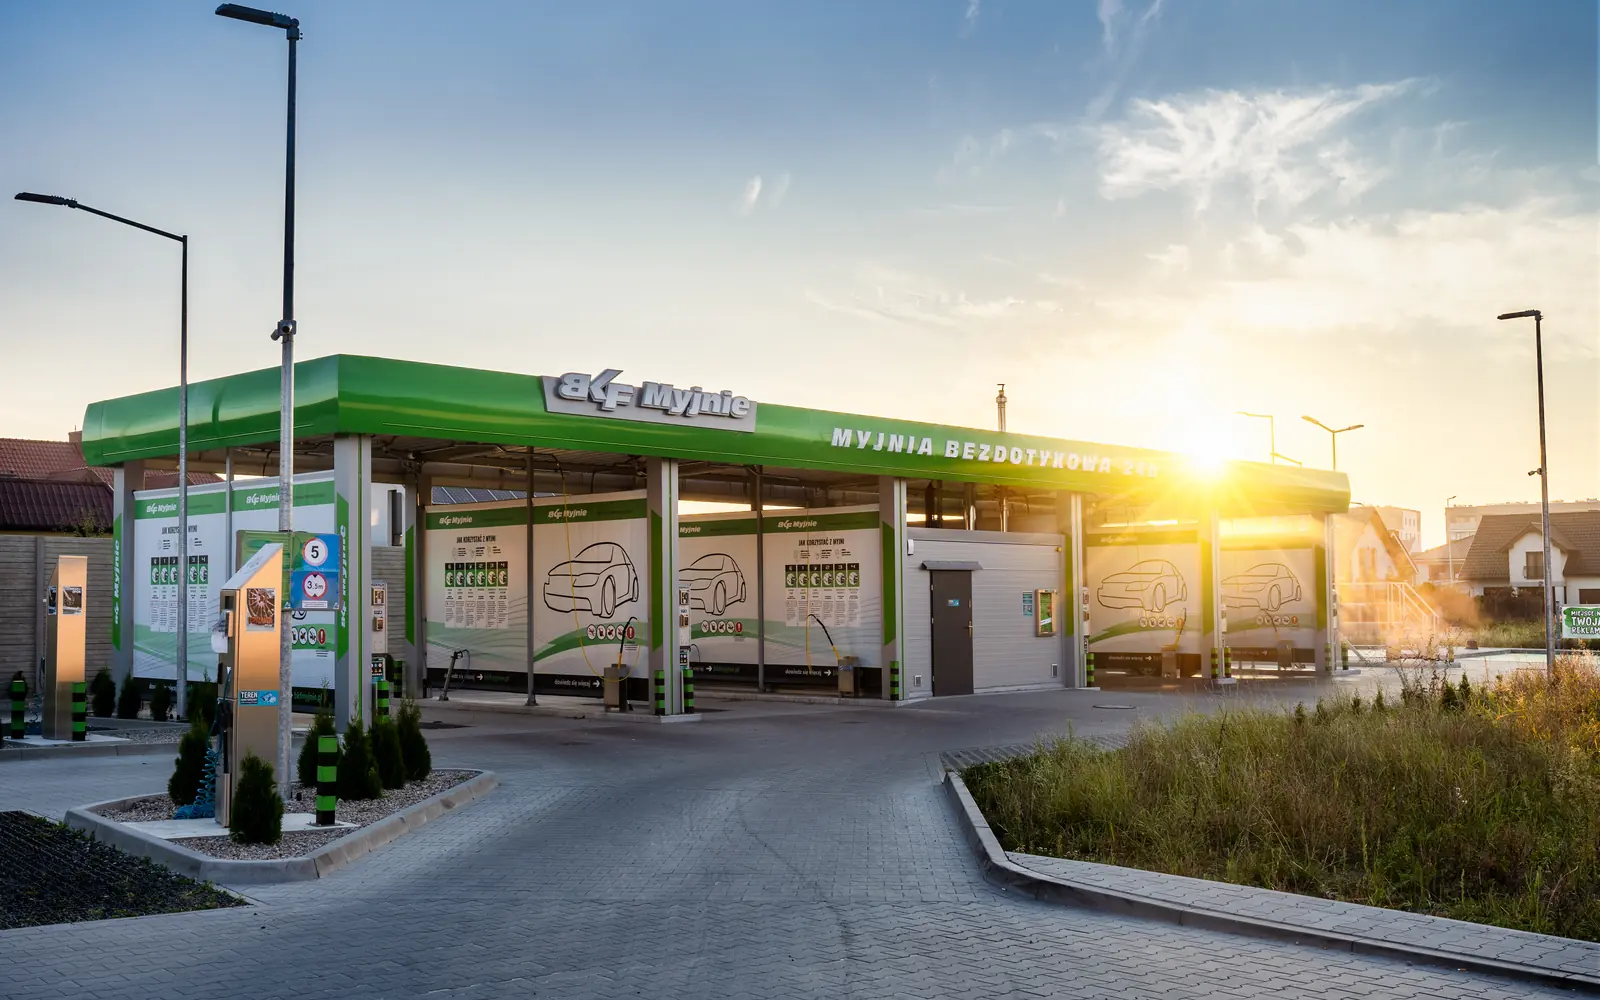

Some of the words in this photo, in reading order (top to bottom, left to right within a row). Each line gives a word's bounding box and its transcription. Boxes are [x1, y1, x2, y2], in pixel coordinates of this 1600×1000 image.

[558, 368, 634, 411] BKF
[641, 381, 751, 418] Myjnie
[831, 427, 932, 456] MYJNIA
[944, 440, 1111, 473] BEZDOTYKOWA
[259, 493, 280, 504] Myjni
[563, 508, 588, 518] Myjnie
[792, 520, 818, 529] Myjnie
[310, 545, 319, 558] 5
[240, 691, 258, 699] TEREN
